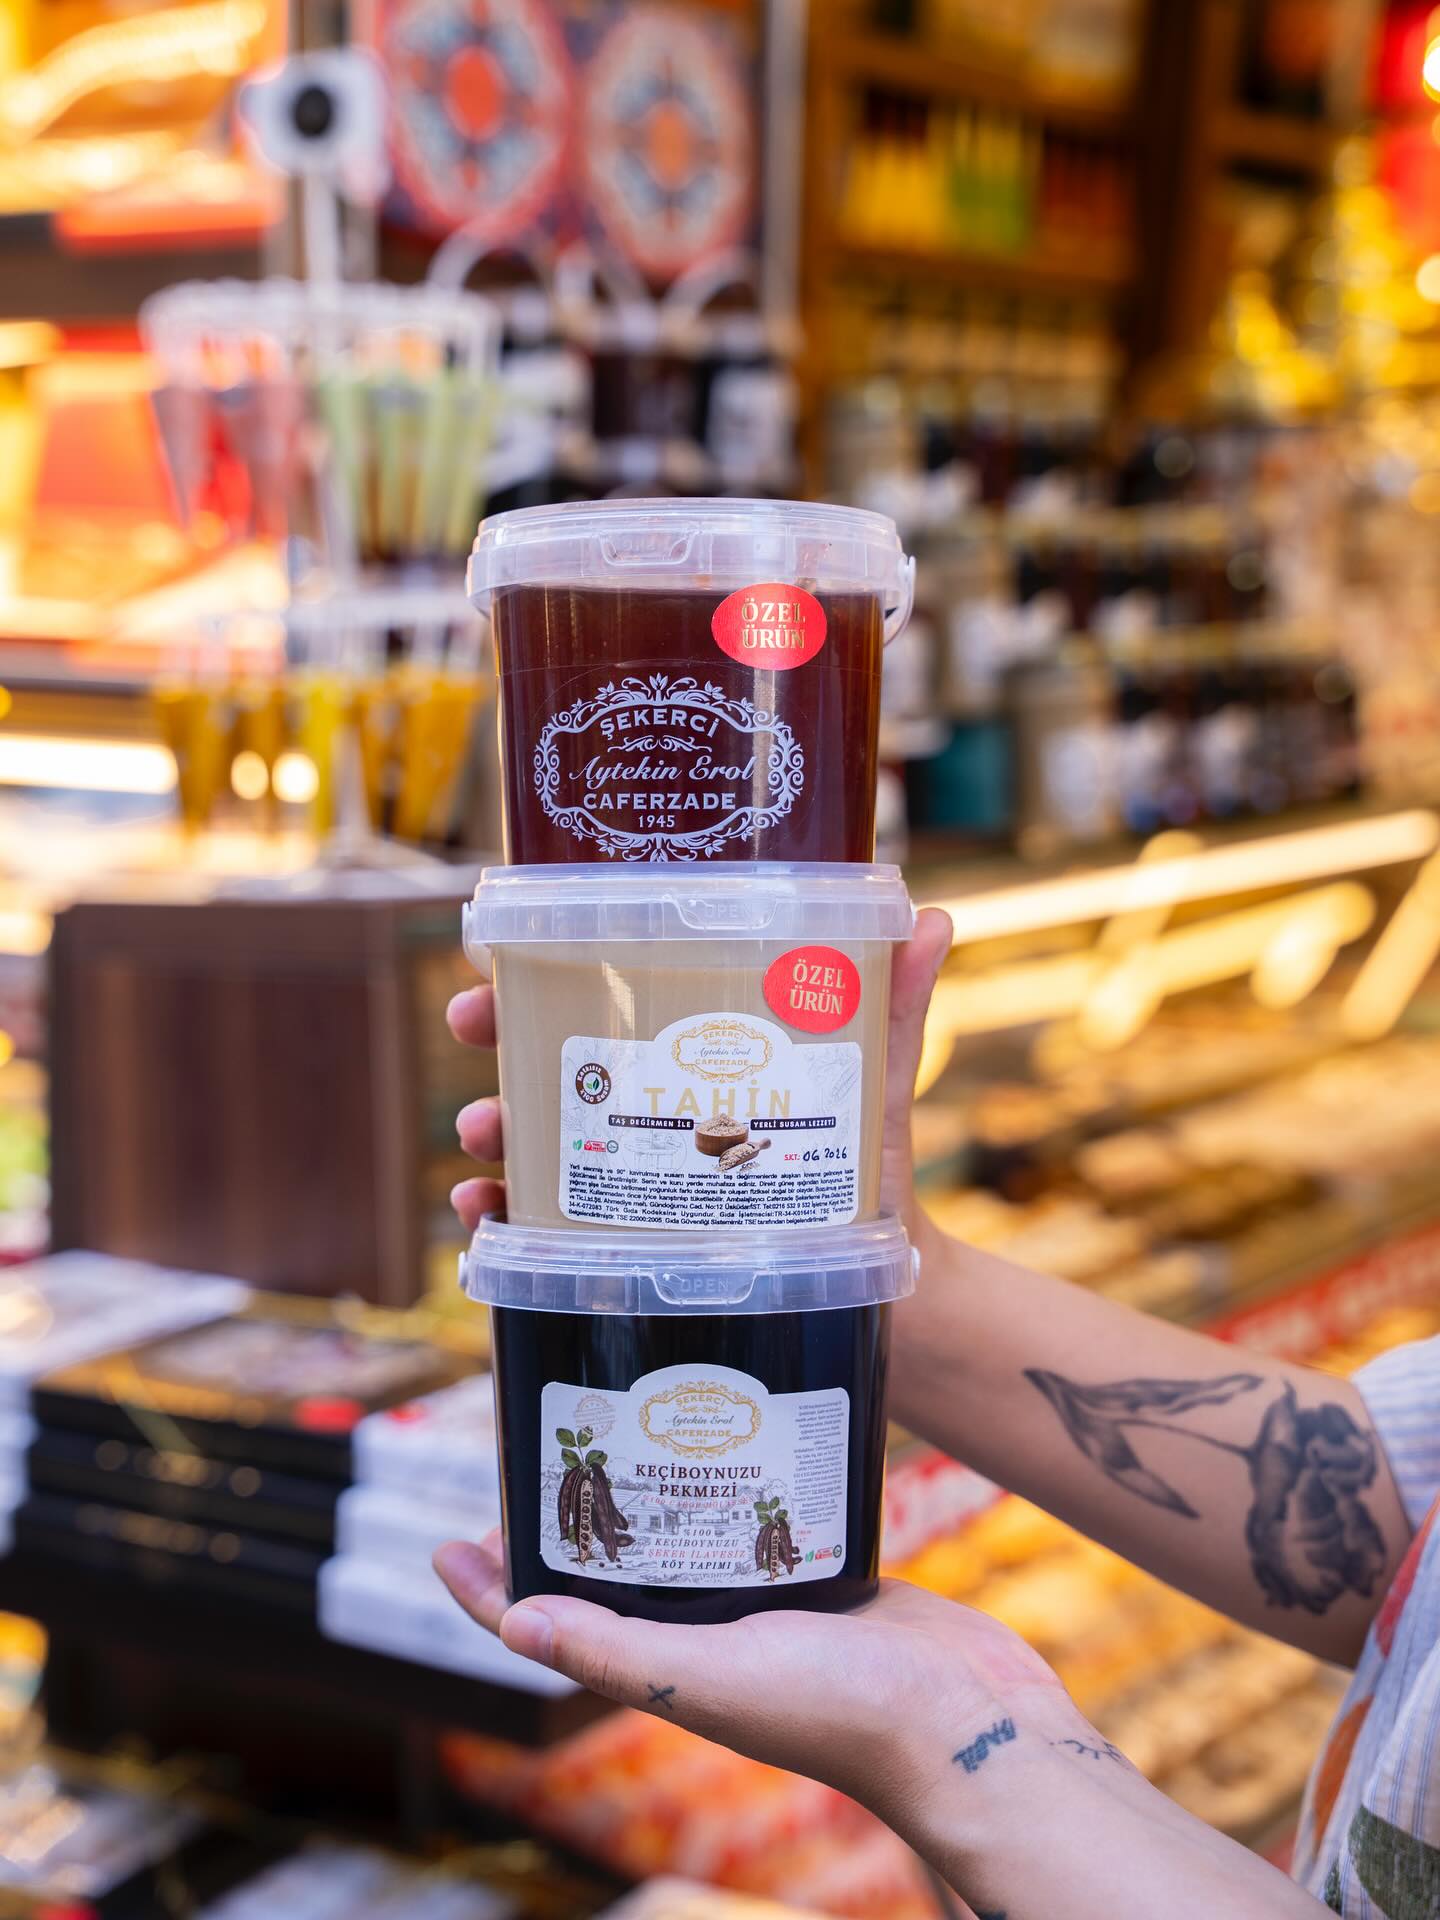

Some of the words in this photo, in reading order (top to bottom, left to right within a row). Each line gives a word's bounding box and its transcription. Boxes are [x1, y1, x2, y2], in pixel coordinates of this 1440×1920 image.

[741, 597, 806, 623] ÖZEL
[743, 624, 806, 649] ÜRÜN
[601, 708, 720, 740] ŞEKERCİ
[569, 755, 682, 790] Aytekin
[689, 755, 758, 781] Erol
[583, 793, 737, 810] CAFERZADE
[637, 815, 676, 829] 1945
[792, 957, 846, 989] ÖZEL
[789, 984, 844, 1015] ÜRÜN
[643, 1079, 791, 1117] TAHİN
[611, 1117, 625, 1125] TAŞ
[629, 1117, 674, 1127] DEĞİRMEN
[677, 1119, 692, 1128] İLE
[753, 1118, 777, 1129] YERLİ
[779, 1118, 807, 1128] SUSAM
[808, 1116, 836, 1127] LEZZETİ
[681, 1278, 730, 1293] OPEN
[665, 1414, 707, 1427] Aytekin
[710, 1414, 735, 1425] Erol
[635, 1462, 762, 1482] KEÇİBOYNUZU
[659, 1482, 738, 1498] PEKMEZİ
[654, 1538, 740, 1549] KEÇİBOYNUZU
[647, 1548, 686, 1560] ŞEKER
[690, 1549, 747, 1559] İLAVESİZ
[660, 1559, 685, 1569] KÖY
[688, 1561, 732, 1571] YAPIMI
